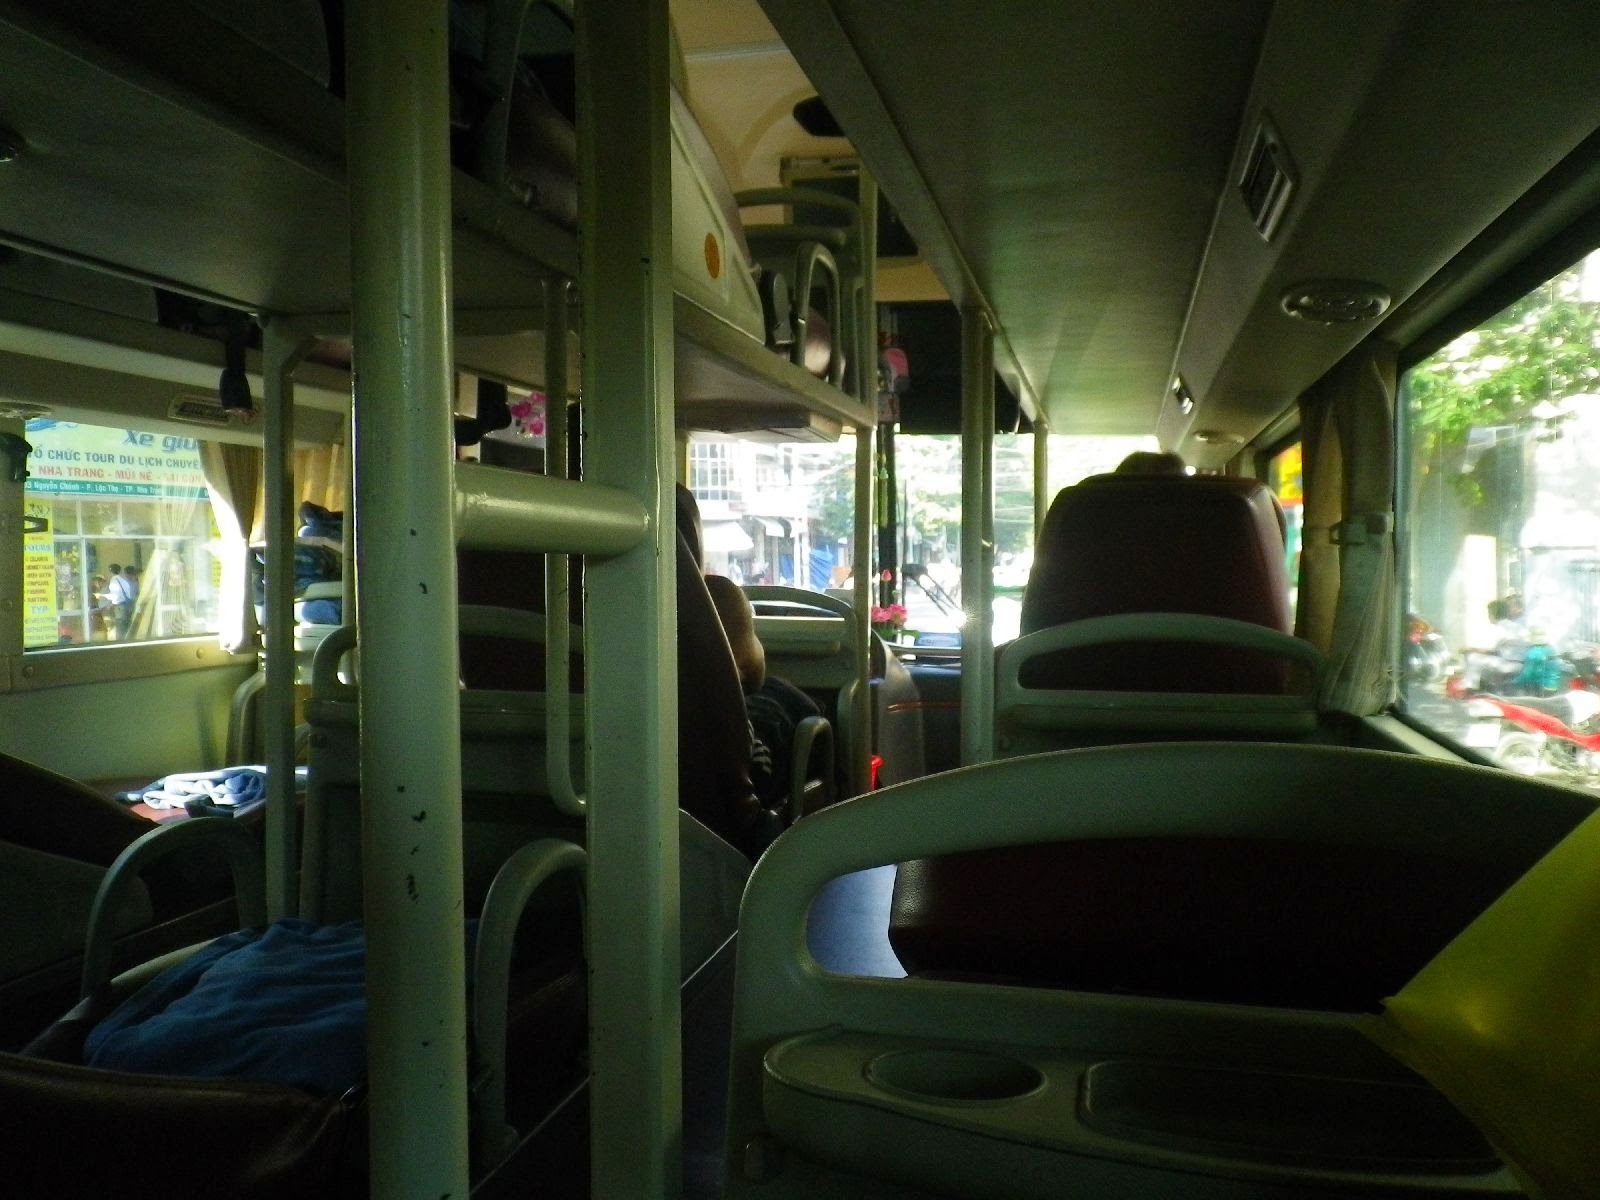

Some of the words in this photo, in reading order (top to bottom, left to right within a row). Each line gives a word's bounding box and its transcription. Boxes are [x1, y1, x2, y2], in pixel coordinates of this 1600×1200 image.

[48, 447, 80, 461] CHỨC
[84, 452, 115, 464] TOUR
[119, 455, 135, 465] DU
[138, 456, 163, 469] LỊCH
[38, 465, 62, 476] NHA
[67, 466, 104, 478] TRANG
